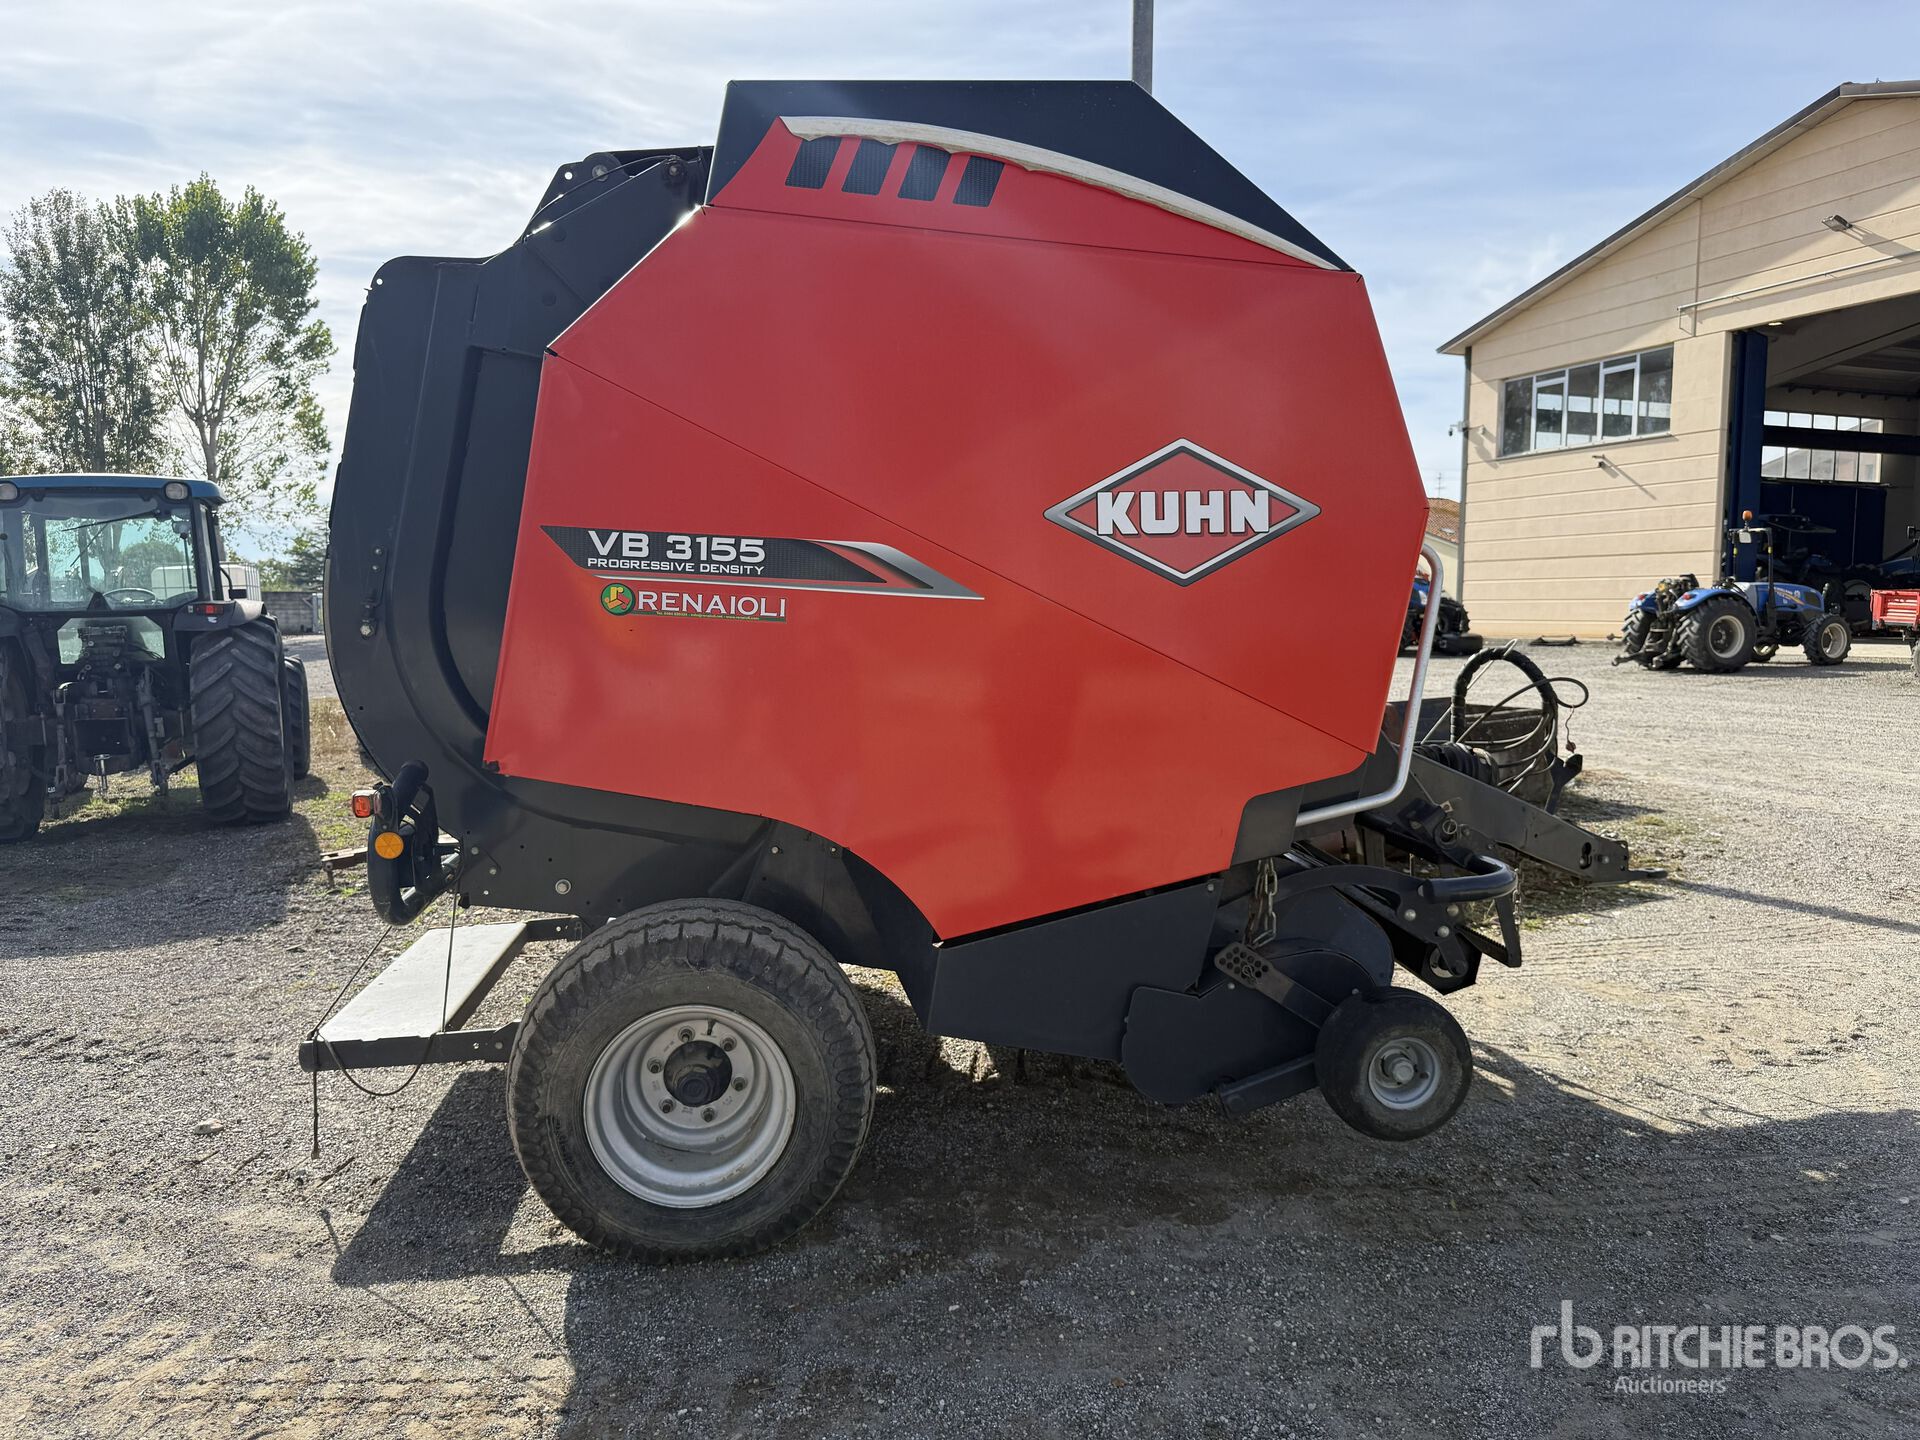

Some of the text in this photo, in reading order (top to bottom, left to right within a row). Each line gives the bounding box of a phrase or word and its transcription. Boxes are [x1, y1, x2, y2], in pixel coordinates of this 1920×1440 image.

[1096, 489, 1270, 536] KUHN
[588, 530, 766, 564] VB 3155
[587, 557, 765, 575] PROGRESSIVE DENSITY
[637, 590, 786, 617] RENAIOLI
